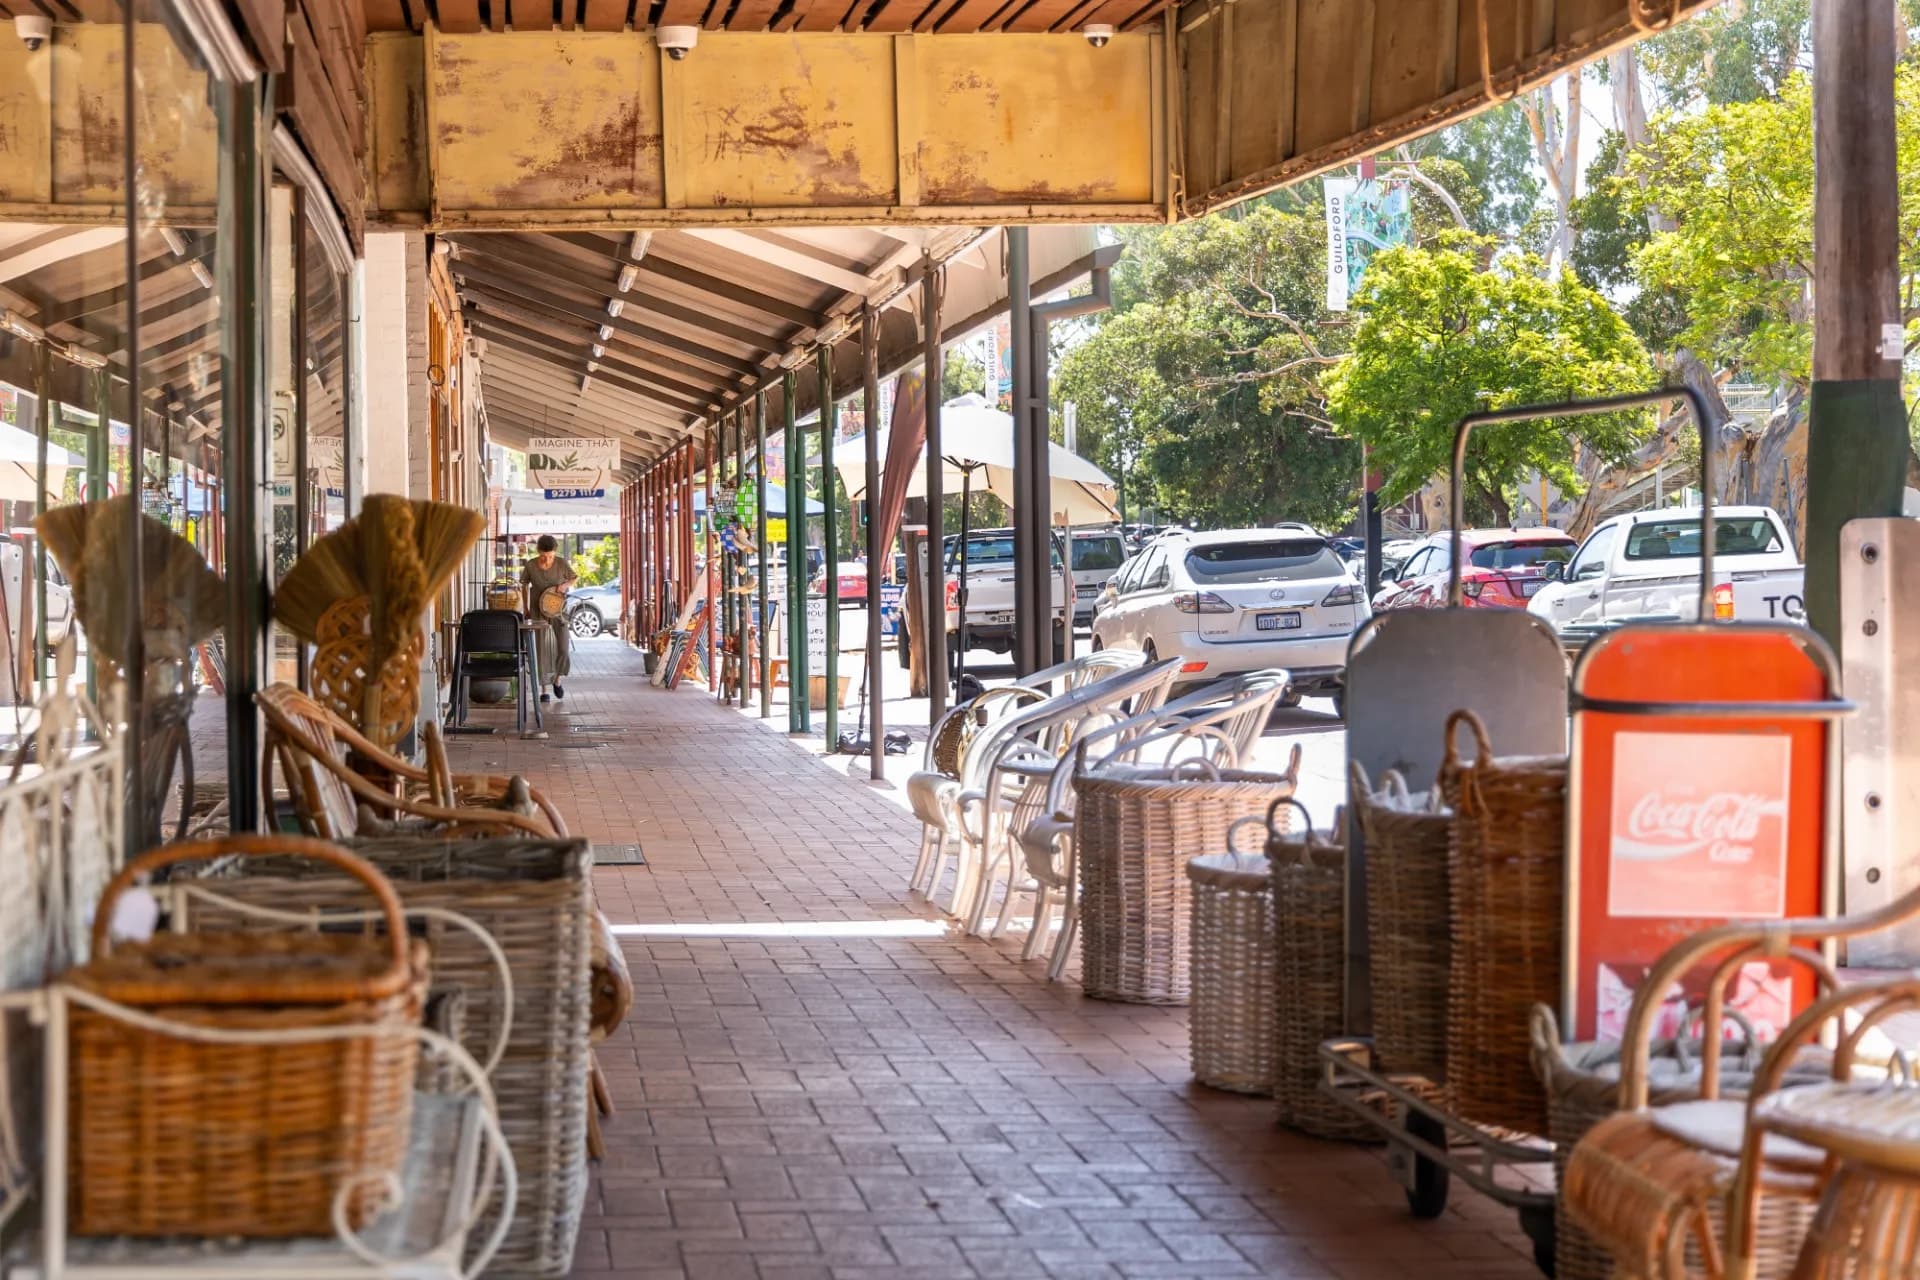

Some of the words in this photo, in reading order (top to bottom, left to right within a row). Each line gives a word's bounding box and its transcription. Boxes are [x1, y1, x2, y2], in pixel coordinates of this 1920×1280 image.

[1331, 198, 1343, 273] GUILDFORD
[987, 329, 996, 381] GUILDFORD
[534, 438, 583, 449] IMAGINE
[585, 438, 616, 448] THAT
[551, 488, 577, 498] 9279
